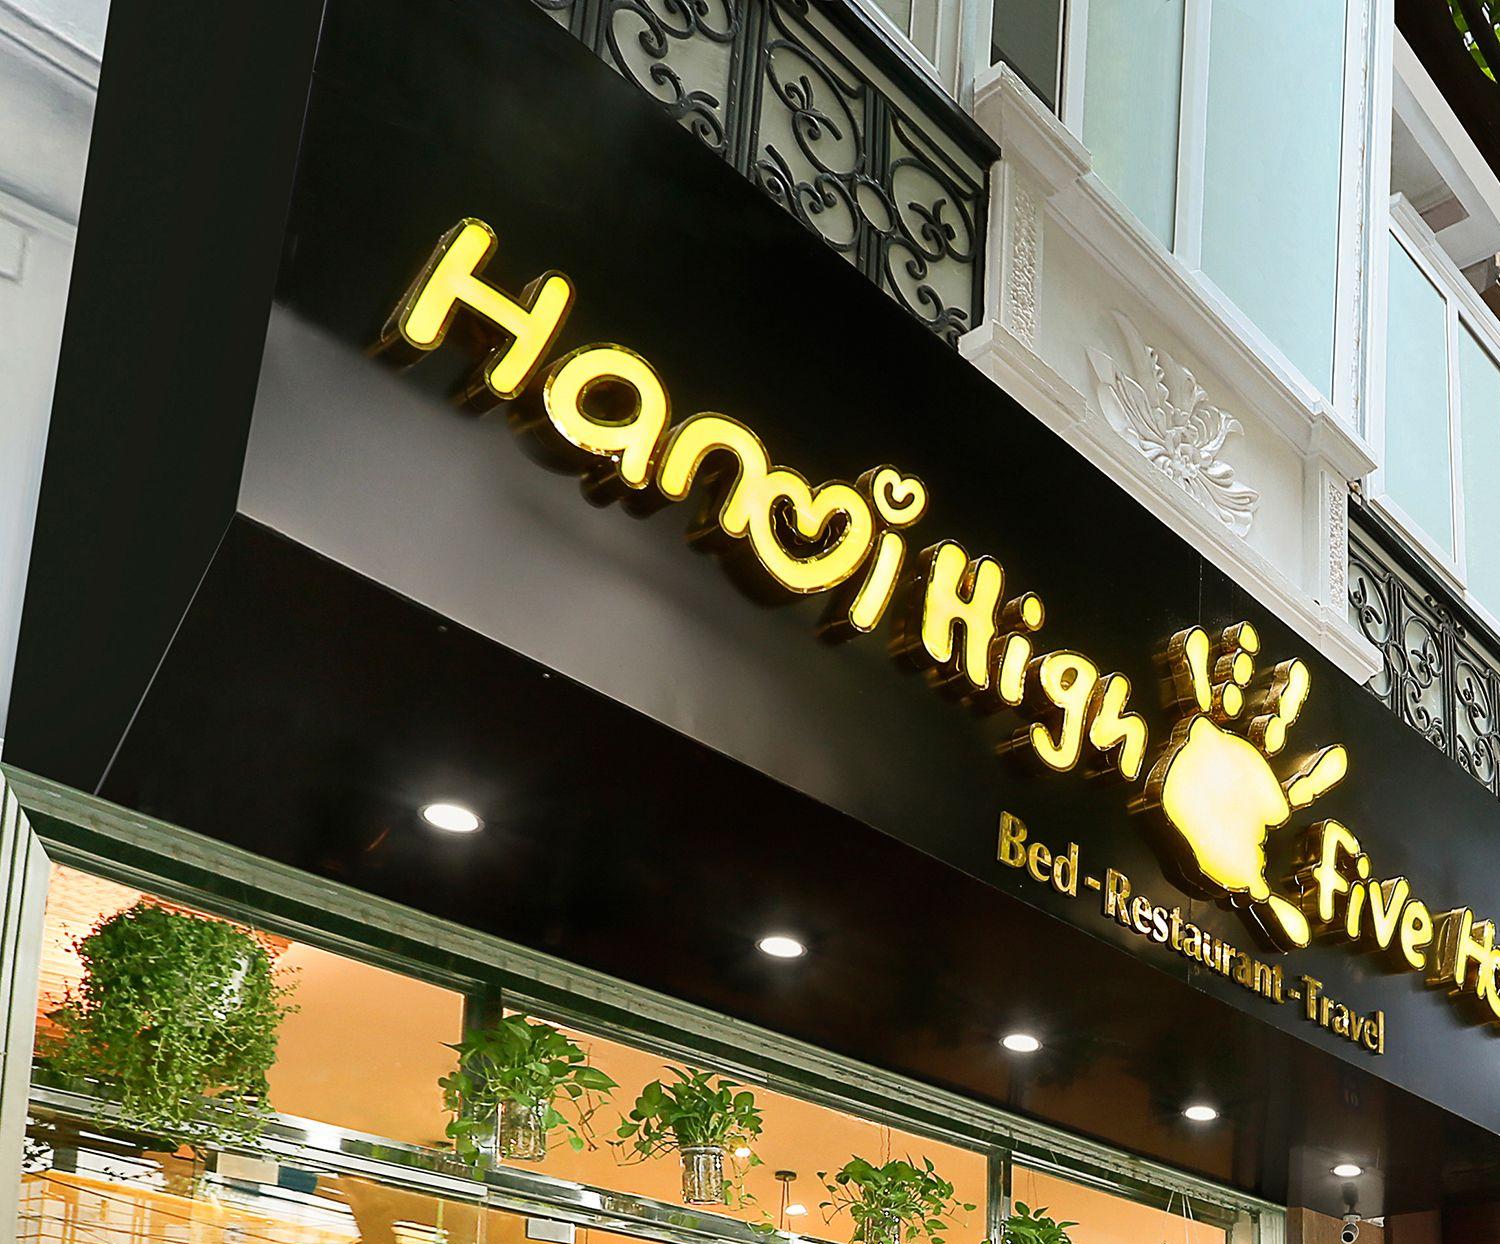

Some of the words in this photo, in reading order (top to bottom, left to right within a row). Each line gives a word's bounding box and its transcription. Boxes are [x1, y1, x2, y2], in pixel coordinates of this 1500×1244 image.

[388, 216, 928, 634] Hanoi
[920, 538, 1148, 784] High
[997, 810, 1079, 898] Bed
[1104, 867, 1285, 1005] Restaurant
[1300, 974, 1386, 1056] Travel
